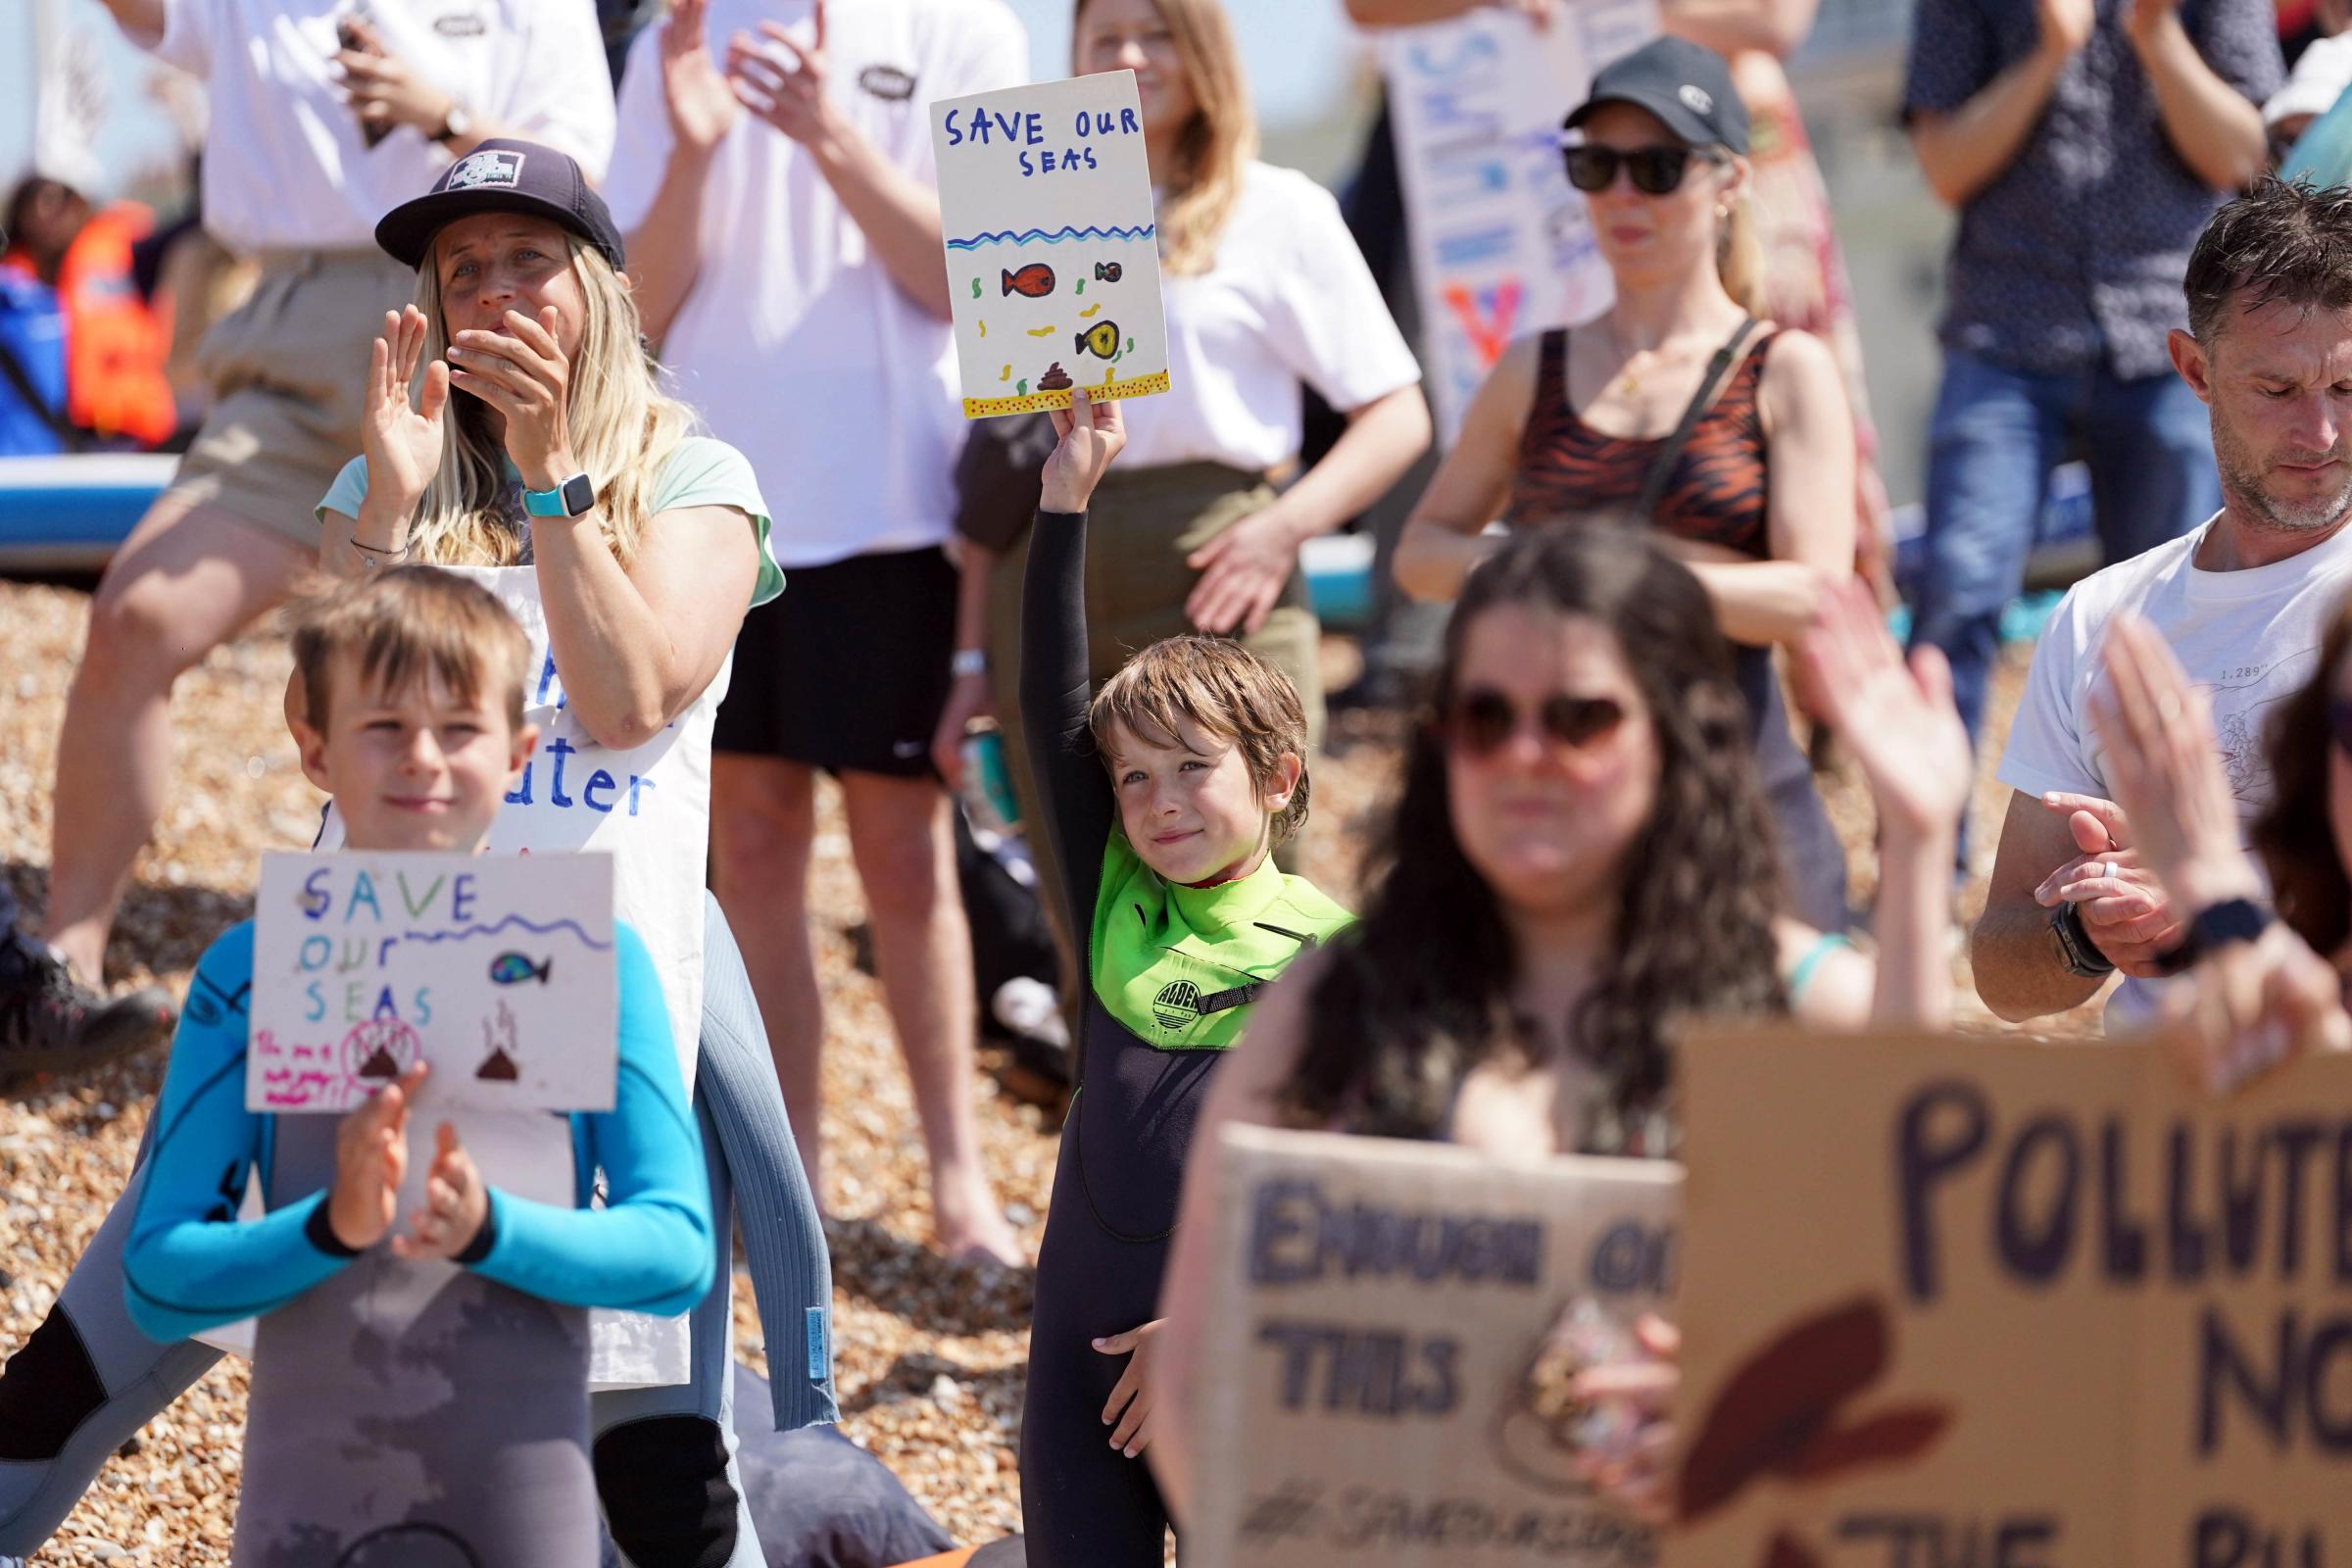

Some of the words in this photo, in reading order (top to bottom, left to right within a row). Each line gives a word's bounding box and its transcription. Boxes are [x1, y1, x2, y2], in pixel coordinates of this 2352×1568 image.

[945, 107, 1045, 146] SAVE
[1075, 108, 1139, 138] OUR
[1018, 147, 1098, 177] SEAS
[302, 866, 477, 922] SAVE
[305, 980, 432, 1026] SEAS
[1256, 1318, 1460, 1418] THIS
